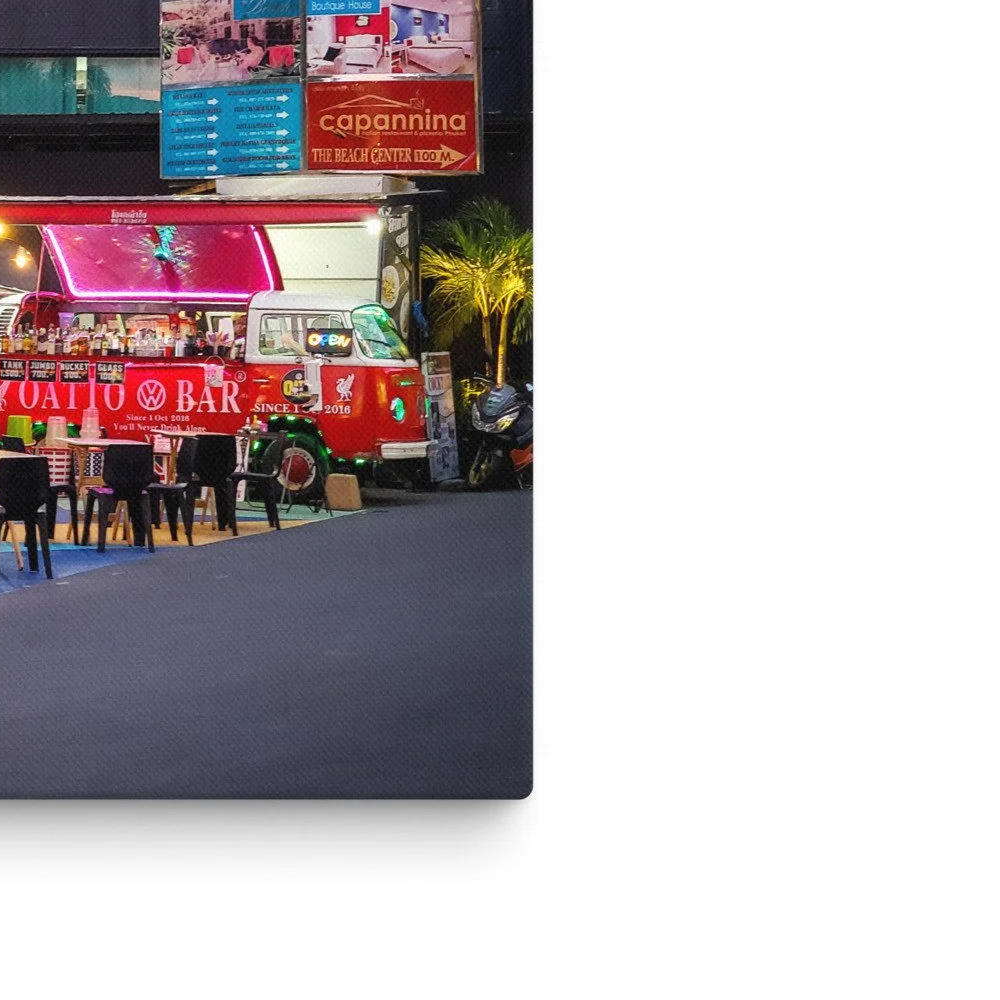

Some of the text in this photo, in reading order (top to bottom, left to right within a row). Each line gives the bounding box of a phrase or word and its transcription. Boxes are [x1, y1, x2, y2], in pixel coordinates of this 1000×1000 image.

[311, 1, 372, 12] Boutique House
[319, 108, 466, 136] capannina
[312, 149, 334, 163] THE
[335, 148, 370, 162] BEACH
[371, 147, 412, 163] CENTER
[416, 151, 437, 162] 100
[307, 333, 352, 348] OPEN
[2, 360, 23, 369] TANK
[29, 361, 56, 370] JUMBO
[60, 362, 89, 371] BUCKET
[97, 363, 124, 372] GLASS
[176, 379, 242, 413] BAR
[253, 403, 290, 413] SINCE
[324, 404, 351, 414] 2016
[136, 423, 158, 431] Never
